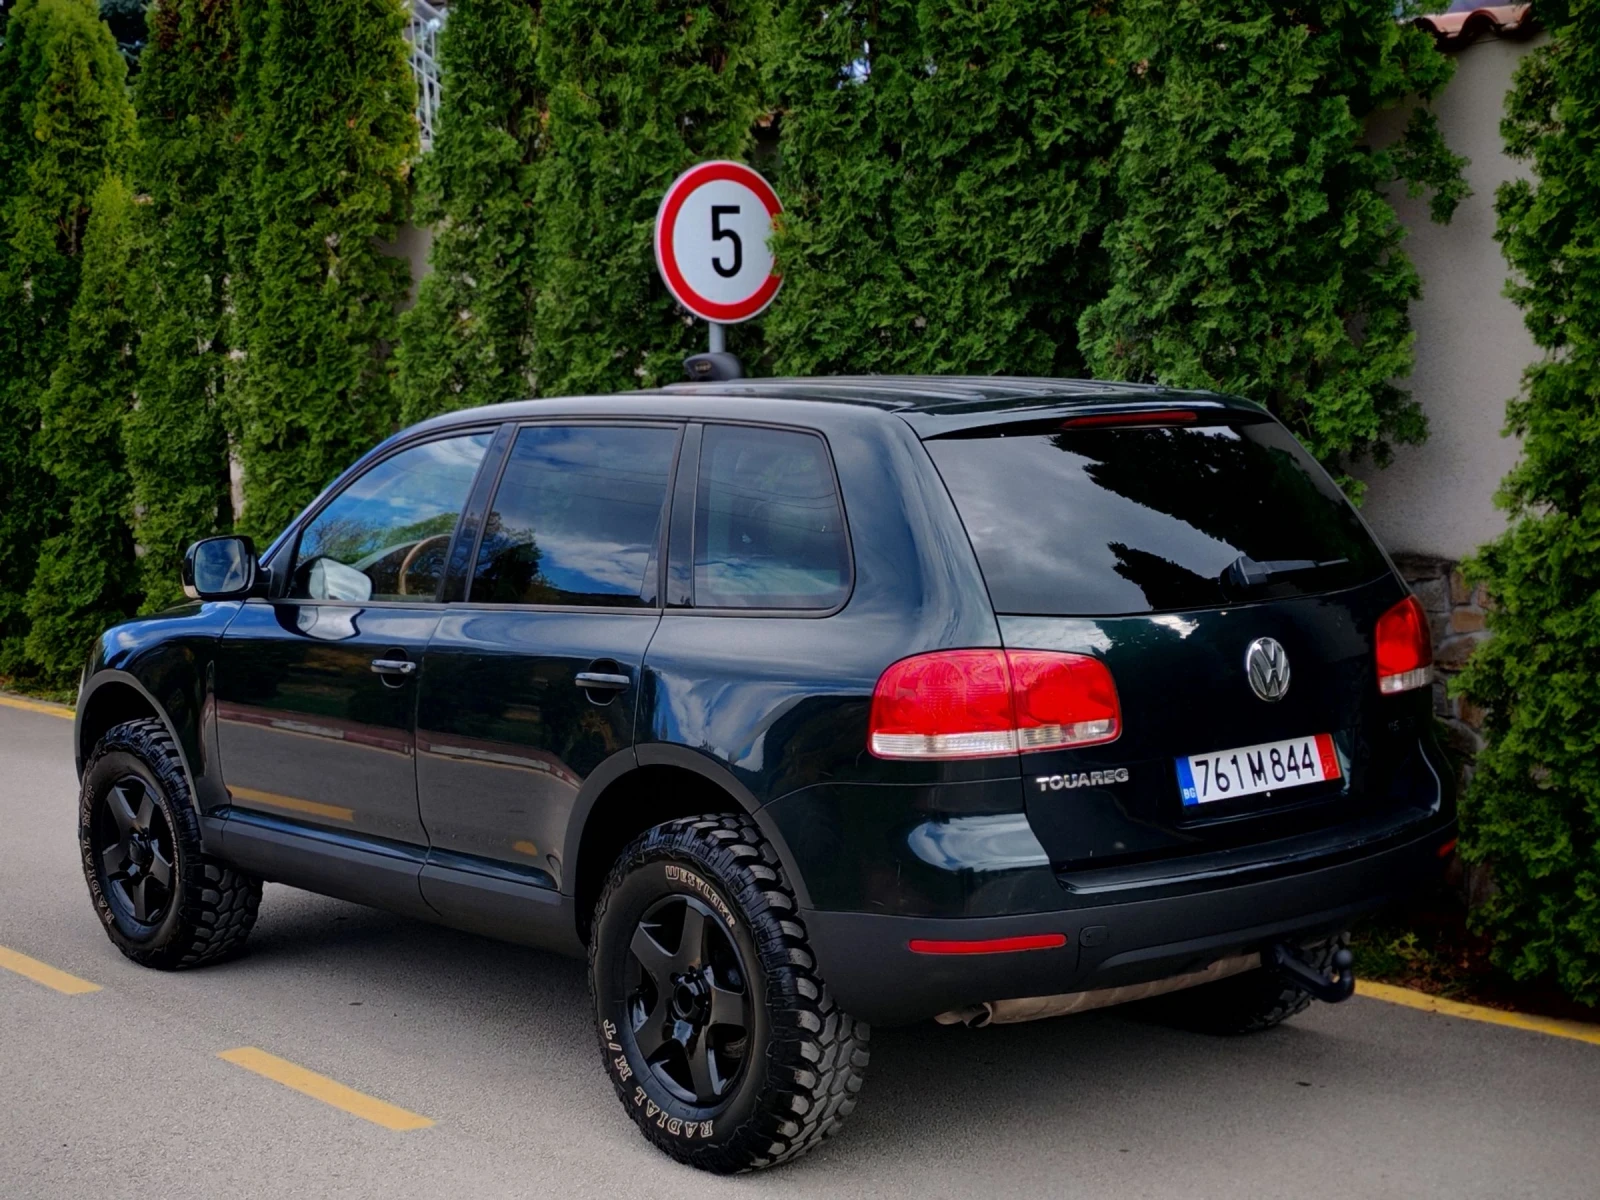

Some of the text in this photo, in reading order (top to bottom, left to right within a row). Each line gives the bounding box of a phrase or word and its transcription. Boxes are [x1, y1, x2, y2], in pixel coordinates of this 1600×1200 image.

[711, 205, 742, 278] 5
[1036, 768, 1129, 792] TOUAREG
[1183, 787, 1197, 800] BG
[1194, 742, 1316, 797] 761M844
[665, 865, 737, 928] WESTLAKE
[603, 1019, 714, 1138] RADIAL M/T
